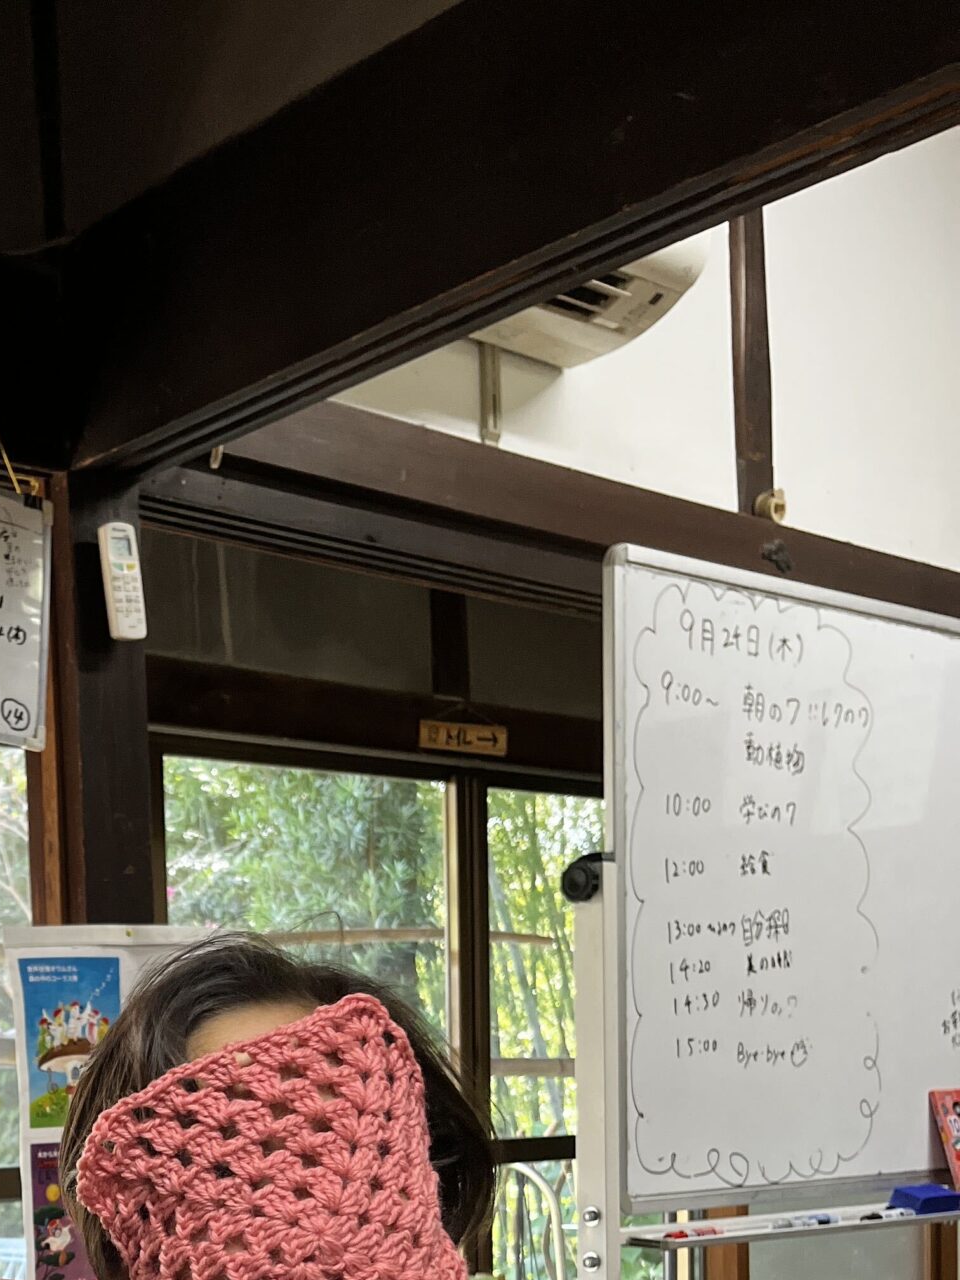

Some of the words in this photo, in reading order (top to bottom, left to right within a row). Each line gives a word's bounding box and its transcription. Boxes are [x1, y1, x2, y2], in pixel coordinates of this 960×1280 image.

[665, 792, 712, 817] 10:00
[664, 857, 705, 884] 12:00
[669, 957, 712, 985] 14:20
[676, 1038, 718, 1059] 15:00
